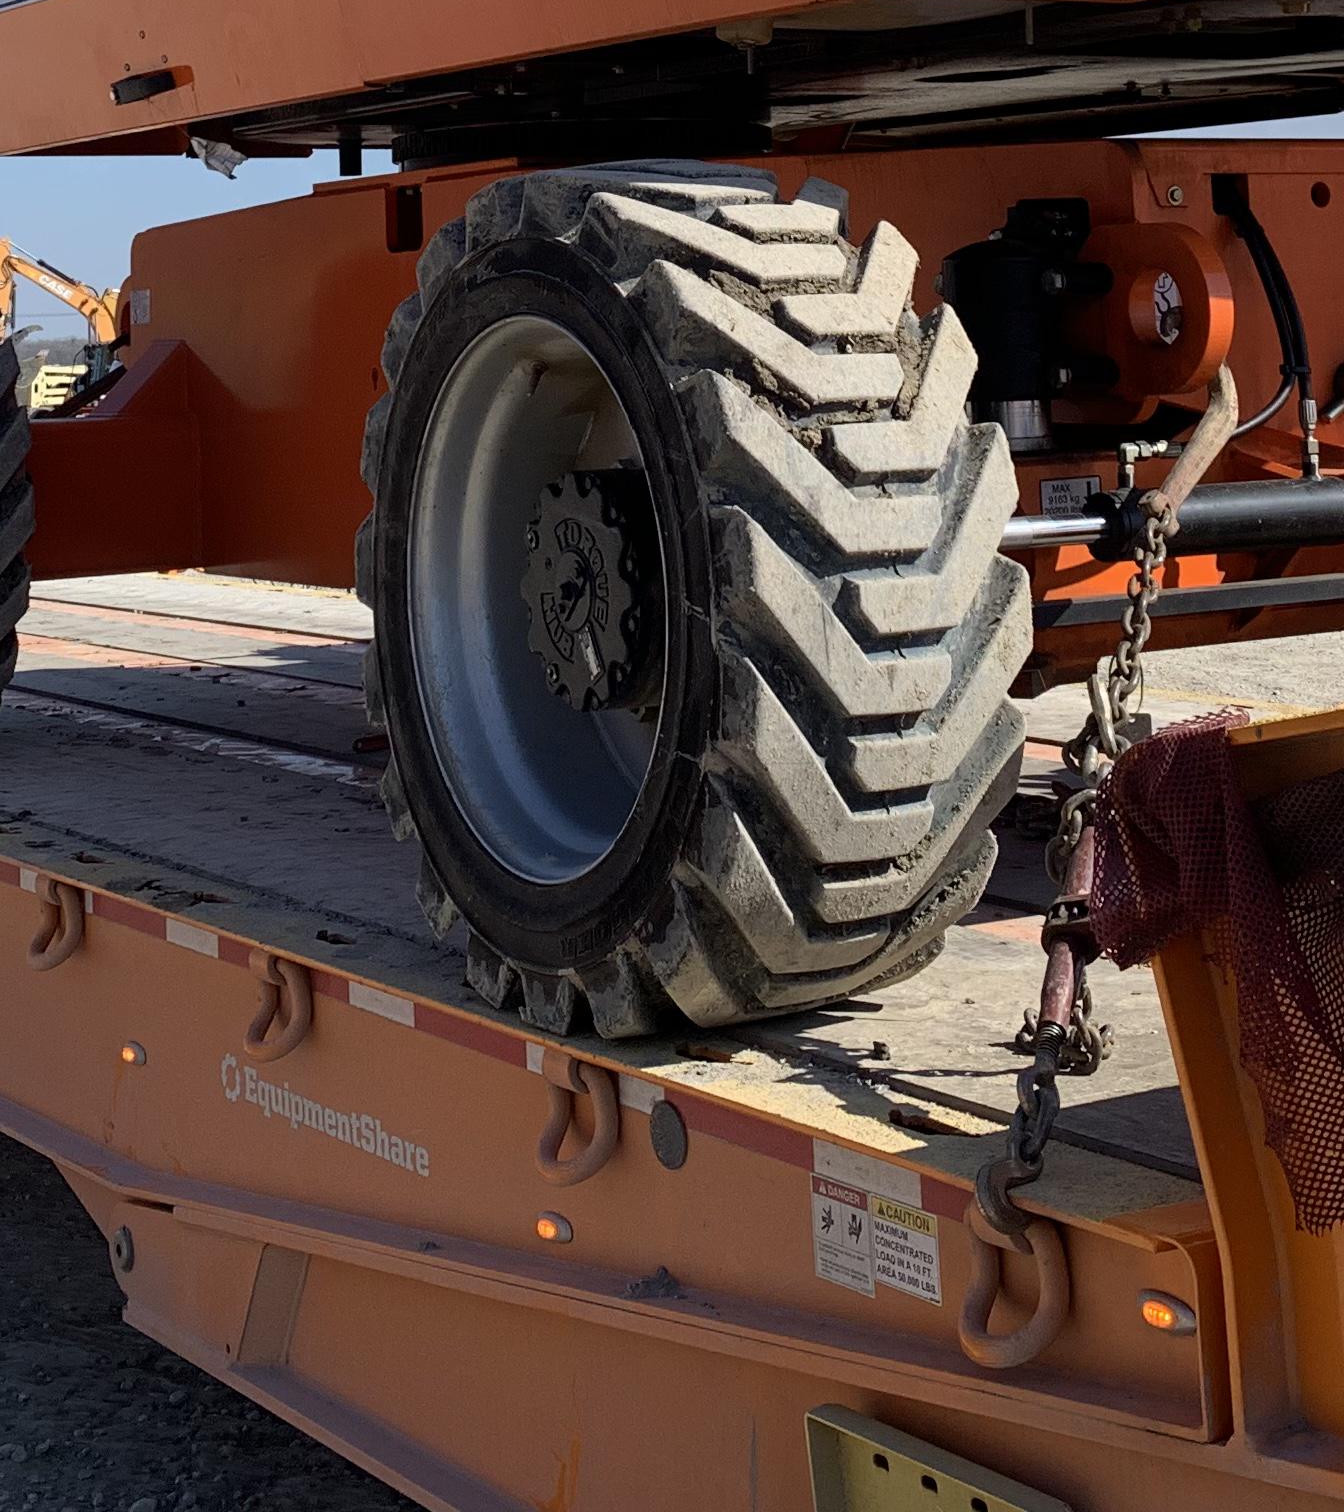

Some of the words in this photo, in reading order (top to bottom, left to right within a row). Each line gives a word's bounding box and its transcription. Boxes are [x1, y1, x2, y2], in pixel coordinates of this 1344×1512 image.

[39, 275, 73, 300] CASE
[1051, 483, 1071, 494] MAX
[1070, 494, 1080, 505] kg
[554, 518, 610, 632] TORQUE
[540, 592, 575, 664] HUB
[244, 1064, 430, 1176] EquipmentShare
[828, 1185, 861, 1204] DANGER
[886, 1204, 930, 1232] CAUTION
[874, 1220, 909, 1241] MAXIMUM
[875, 1235, 934, 1265] CONCENTRATED
[875, 1250, 896, 1266] LOAD
[897, 1257, 905, 1269] IN
[906, 1261, 912, 1271] A
[877, 1264, 897, 1280] AREA
